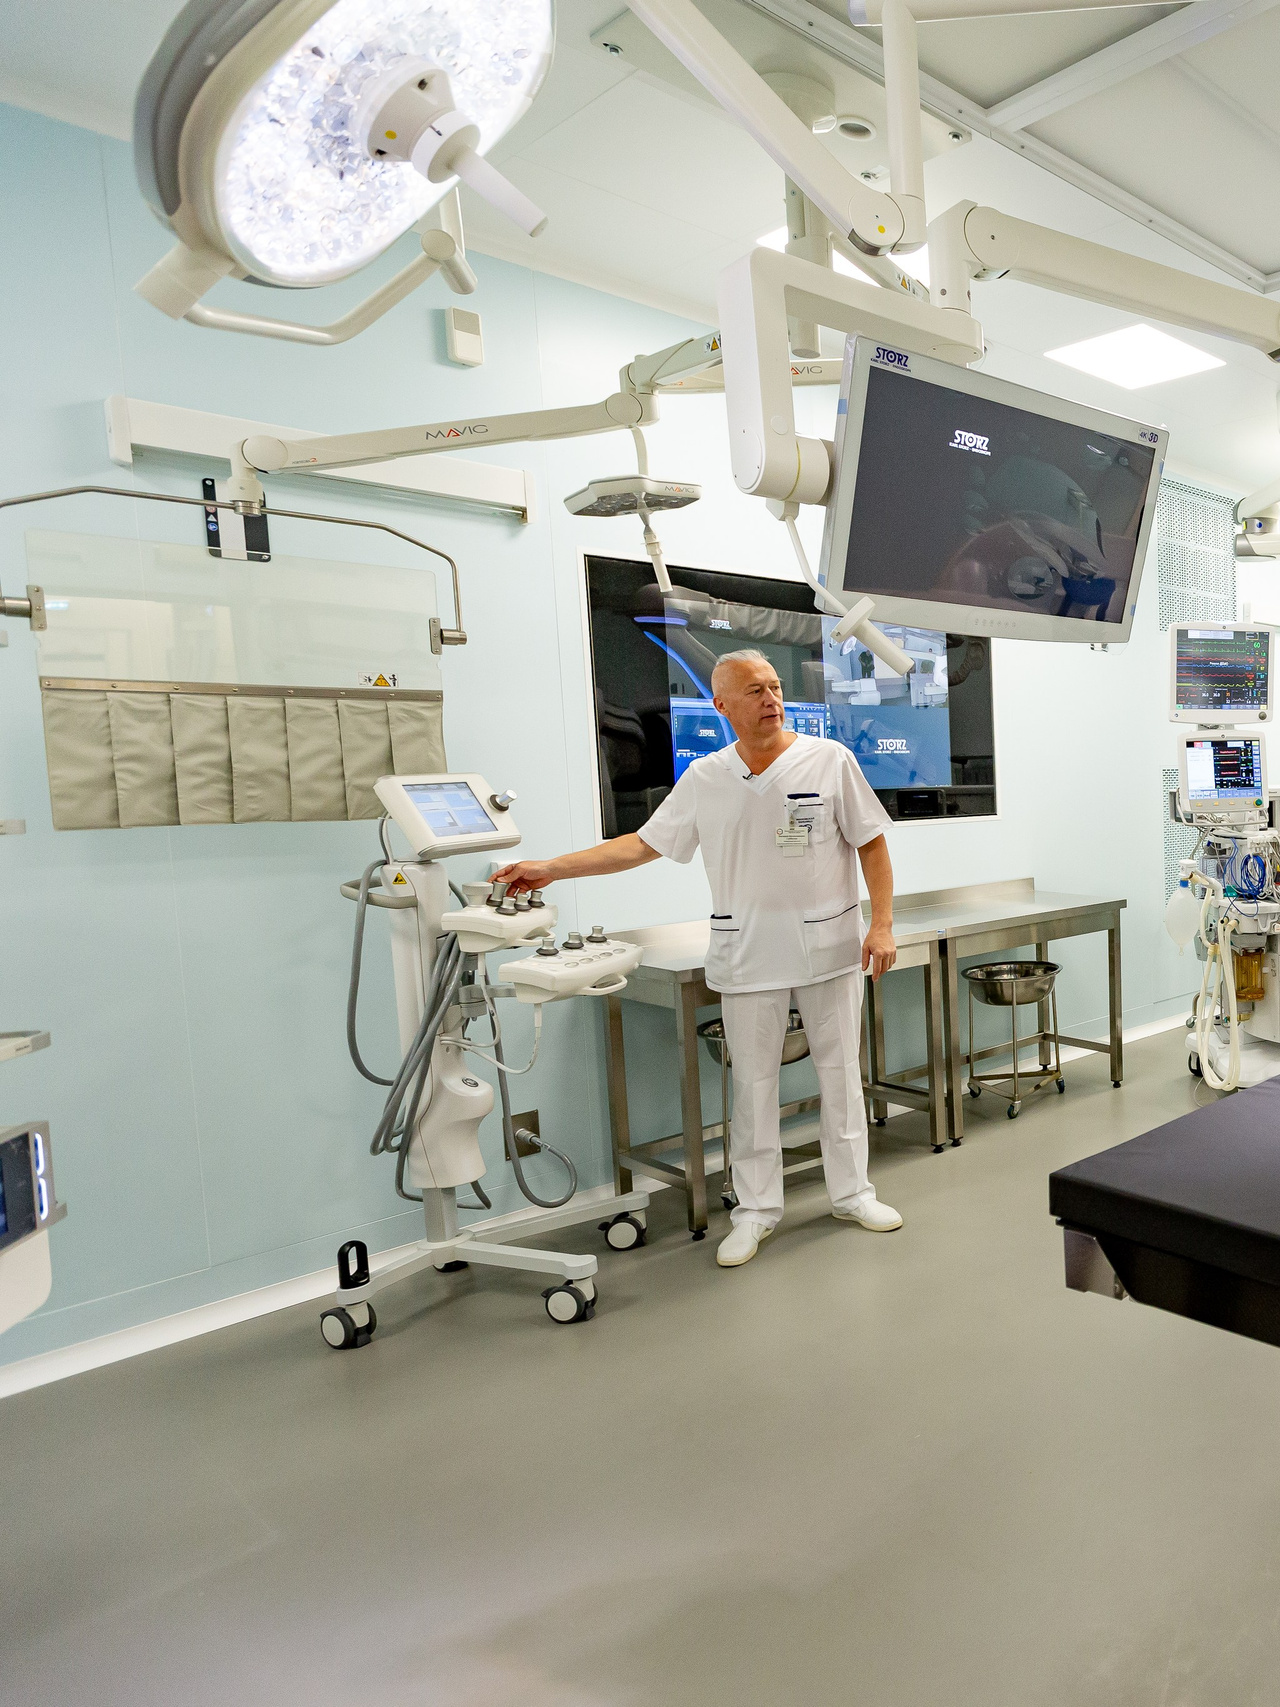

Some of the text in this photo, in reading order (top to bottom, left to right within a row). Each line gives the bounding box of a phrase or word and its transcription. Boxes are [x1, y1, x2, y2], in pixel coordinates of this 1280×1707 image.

[875, 346, 909, 367] STORZ
[790, 365, 823, 376] AVIG
[425, 424, 489, 440] MAVIG
[953, 429, 990, 451] STORZ
[877, 738, 907, 751] STORZ
